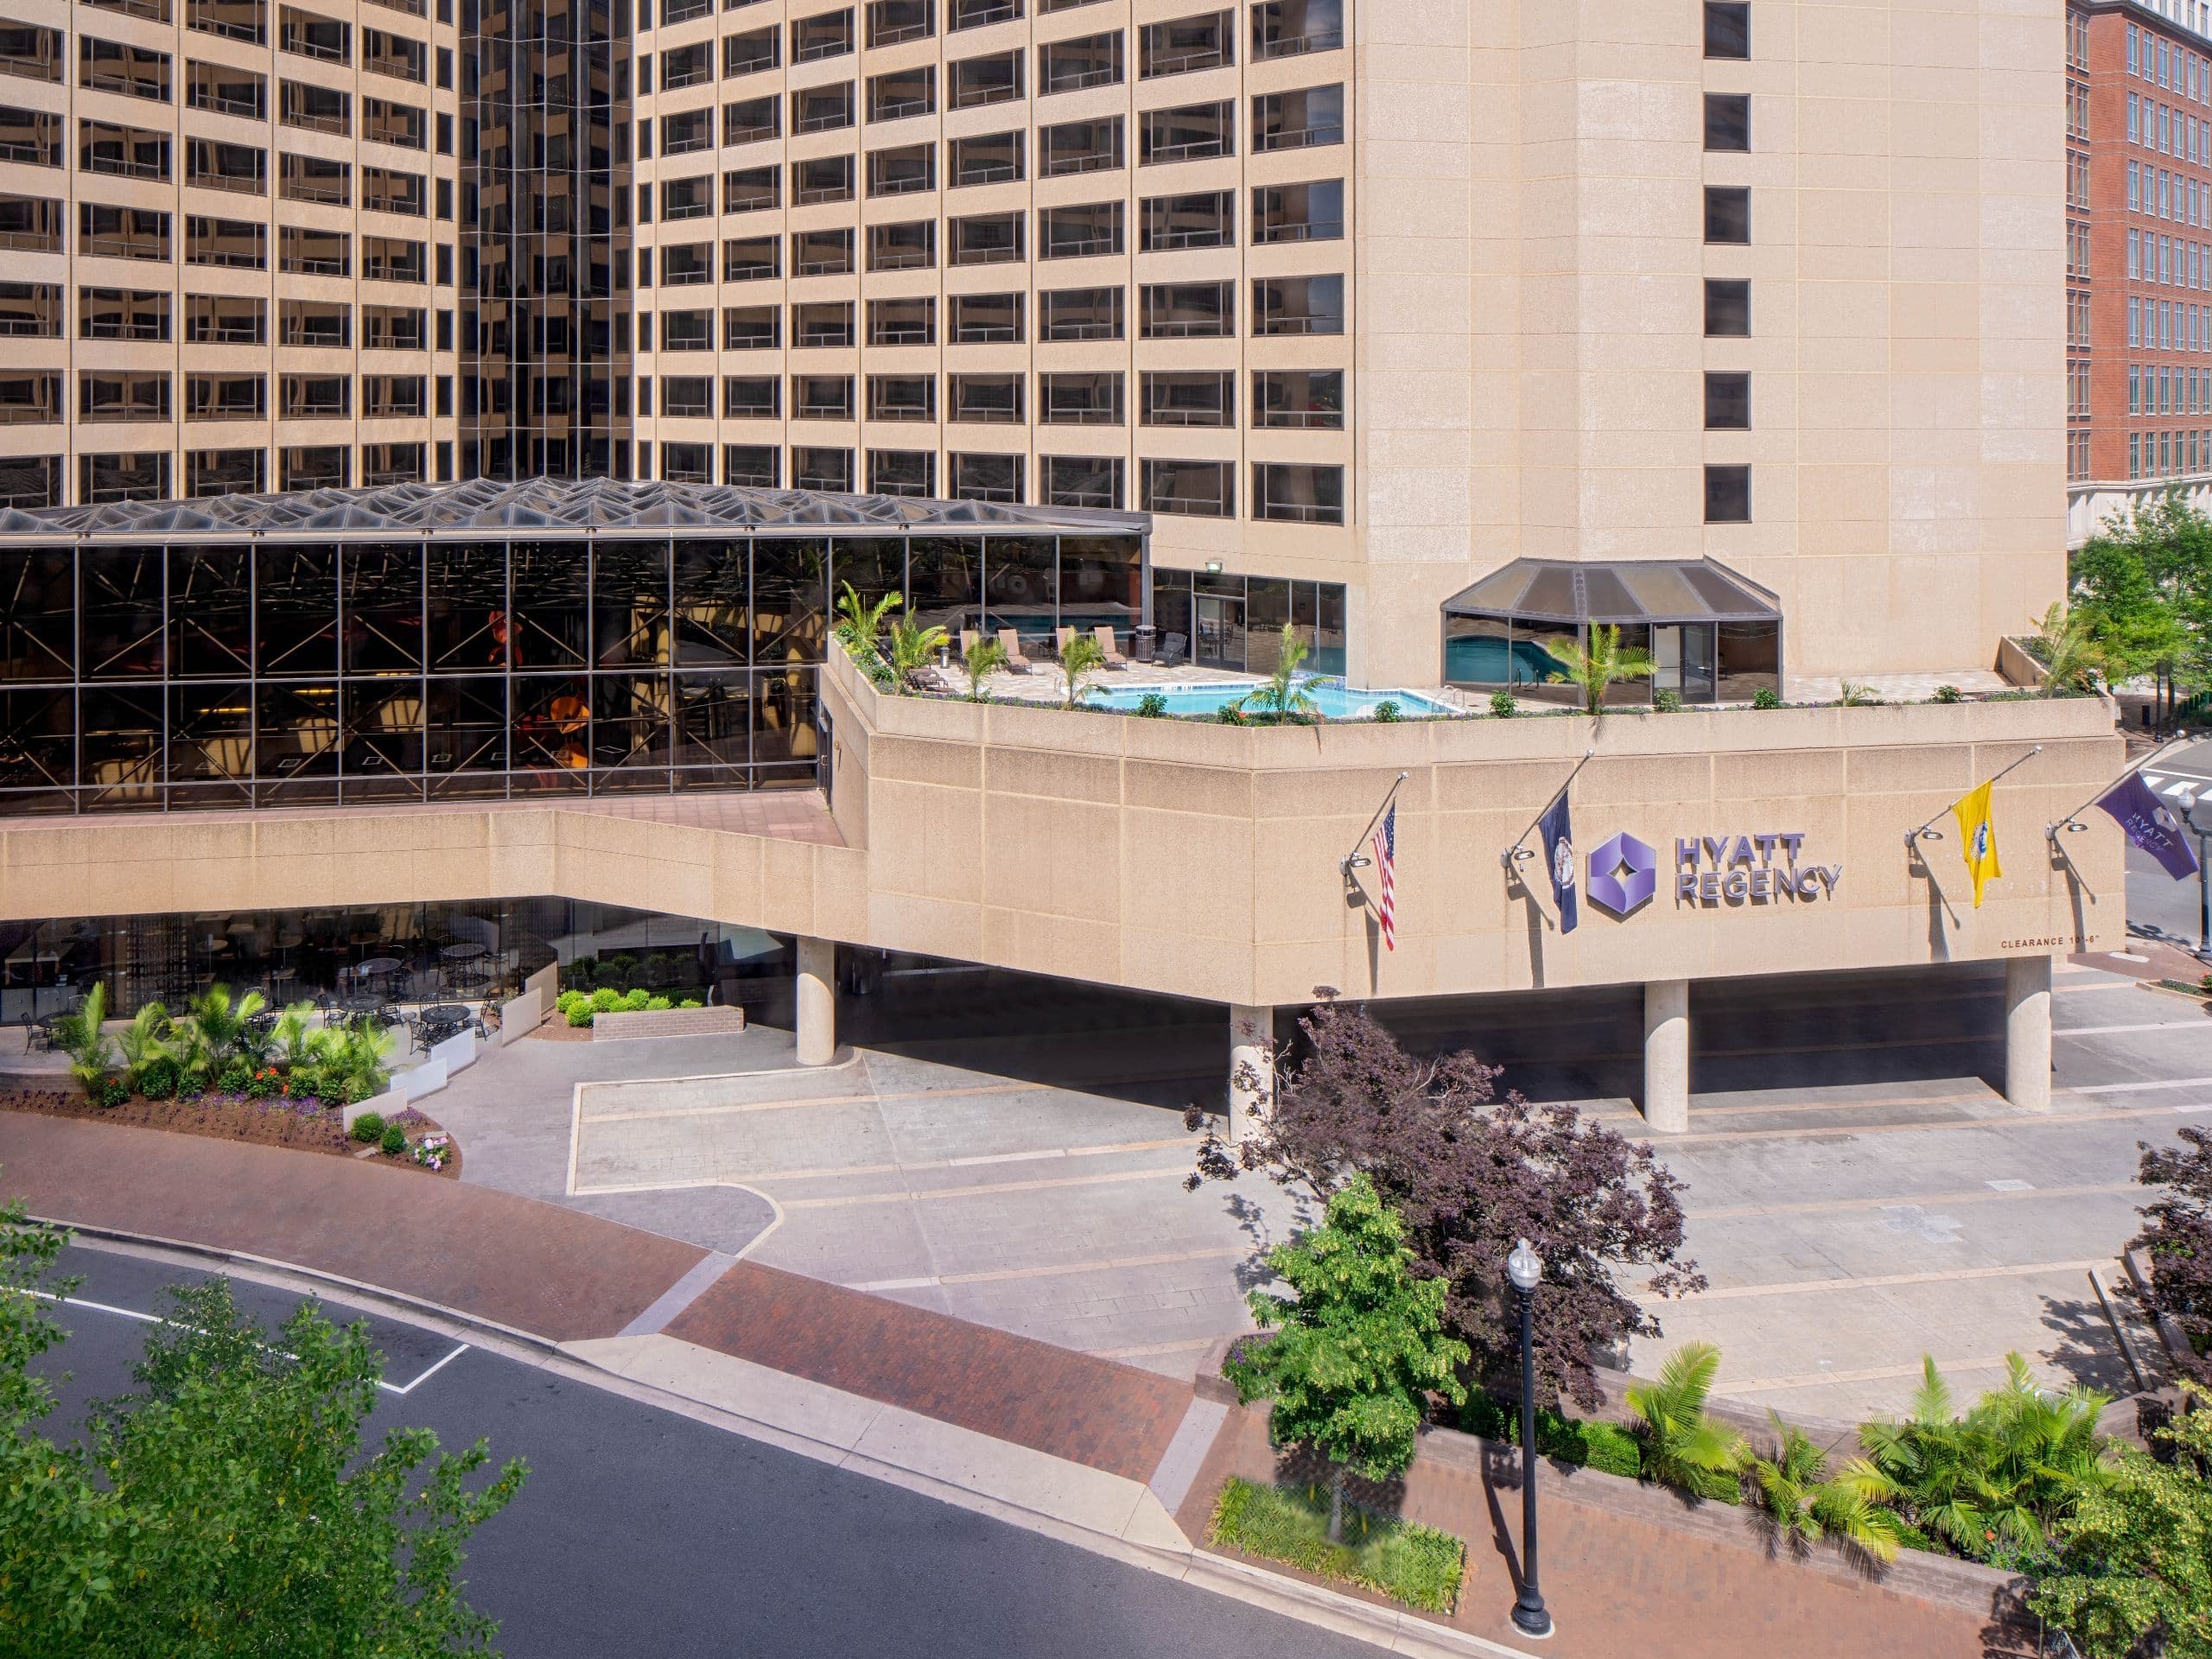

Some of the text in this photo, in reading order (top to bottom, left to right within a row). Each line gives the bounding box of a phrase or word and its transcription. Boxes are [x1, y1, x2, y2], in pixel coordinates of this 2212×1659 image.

[2132, 812, 2174, 847] HYATT
[1675, 834, 1805, 865] HYATT
[1675, 864, 1842, 900] REGENCY
[2000, 938, 2064, 949] CLEARANCE
